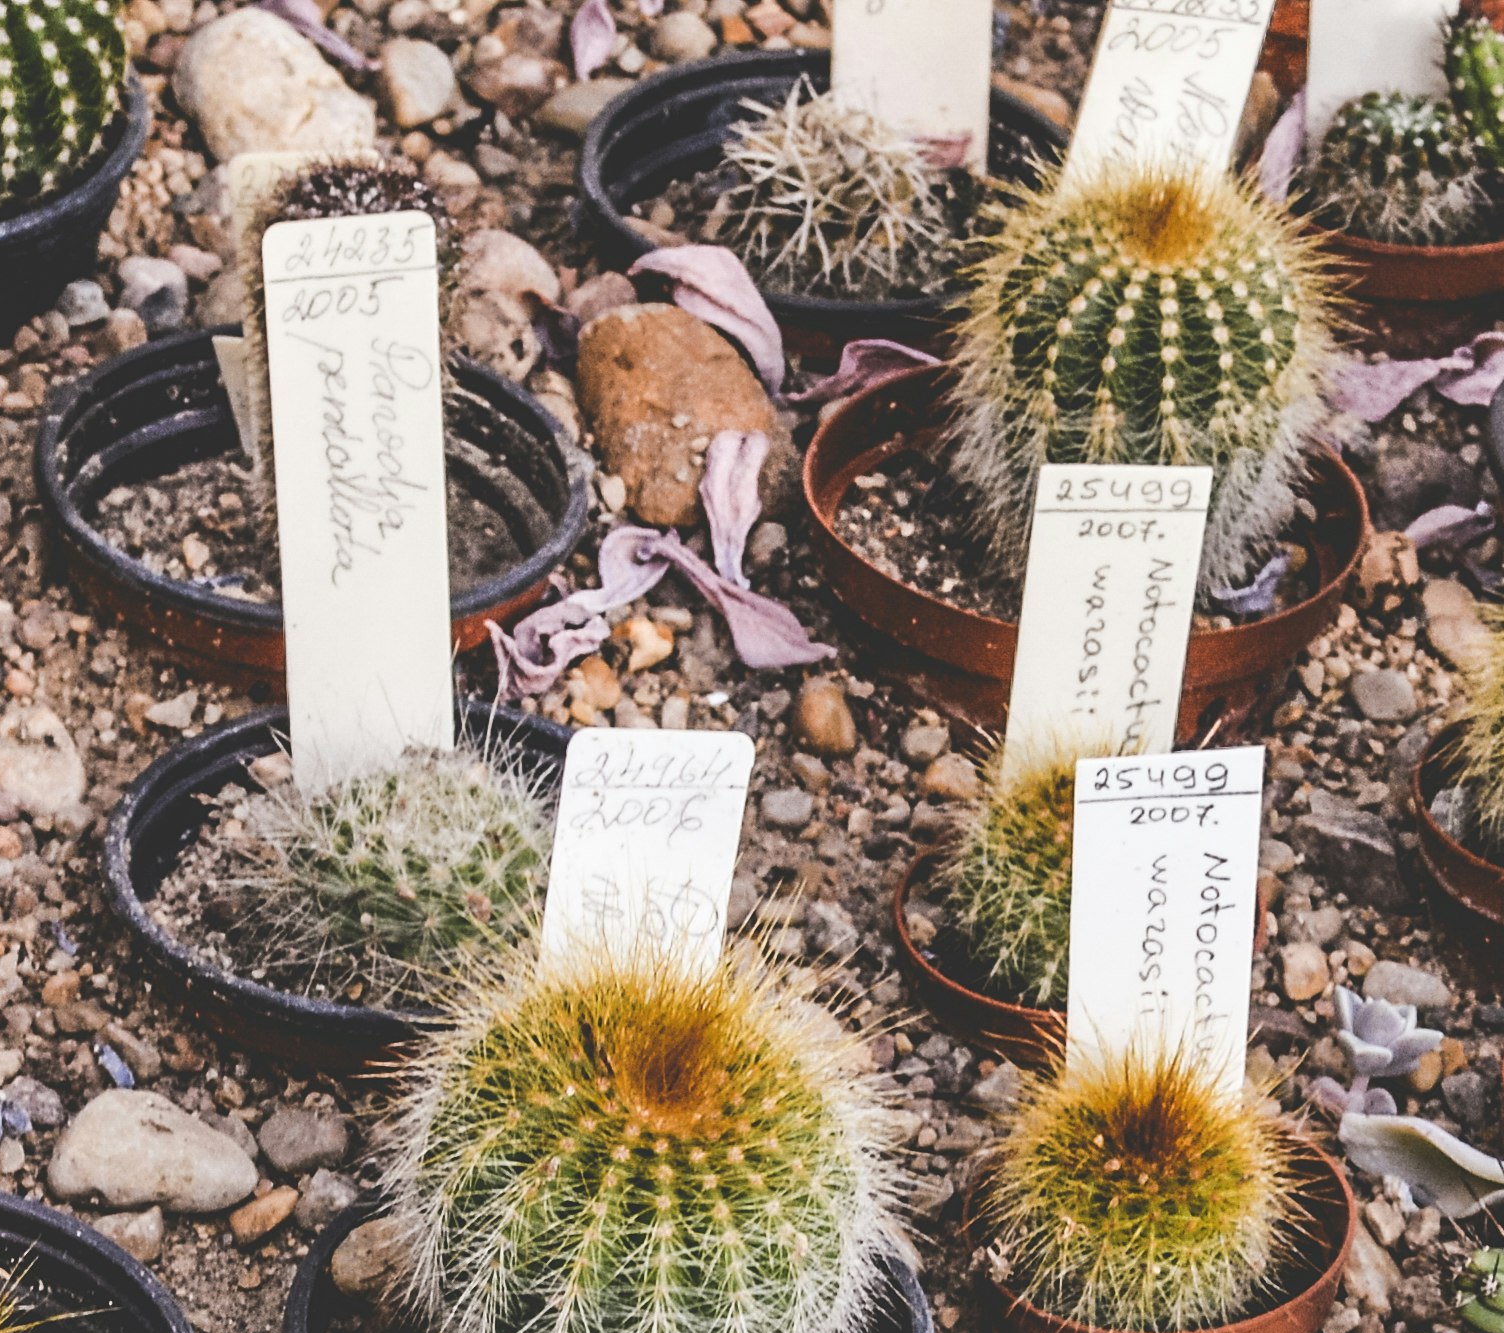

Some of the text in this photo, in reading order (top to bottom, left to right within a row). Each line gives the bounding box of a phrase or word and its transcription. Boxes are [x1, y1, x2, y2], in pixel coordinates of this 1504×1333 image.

[1104, 16, 1241, 61] 2005
[283, 217, 437, 273] 24235
[278, 274, 406, 324] 2005
[367, 335, 435, 541] Parodia
[1053, 475, 1194, 512] 25499
[1075, 517, 1166, 543] 2007.
[1071, 562, 1111, 716] warasii
[1115, 556, 1177, 757] Notocactu
[568, 742, 734, 793] 24964
[1092, 760, 1229, 793] 25499
[567, 783, 709, 848] 2006
[1128, 801, 1219, 828] 2007.
[1136, 852, 1170, 1016] warasii
[1192, 850, 1236, 1065] Notocactu
